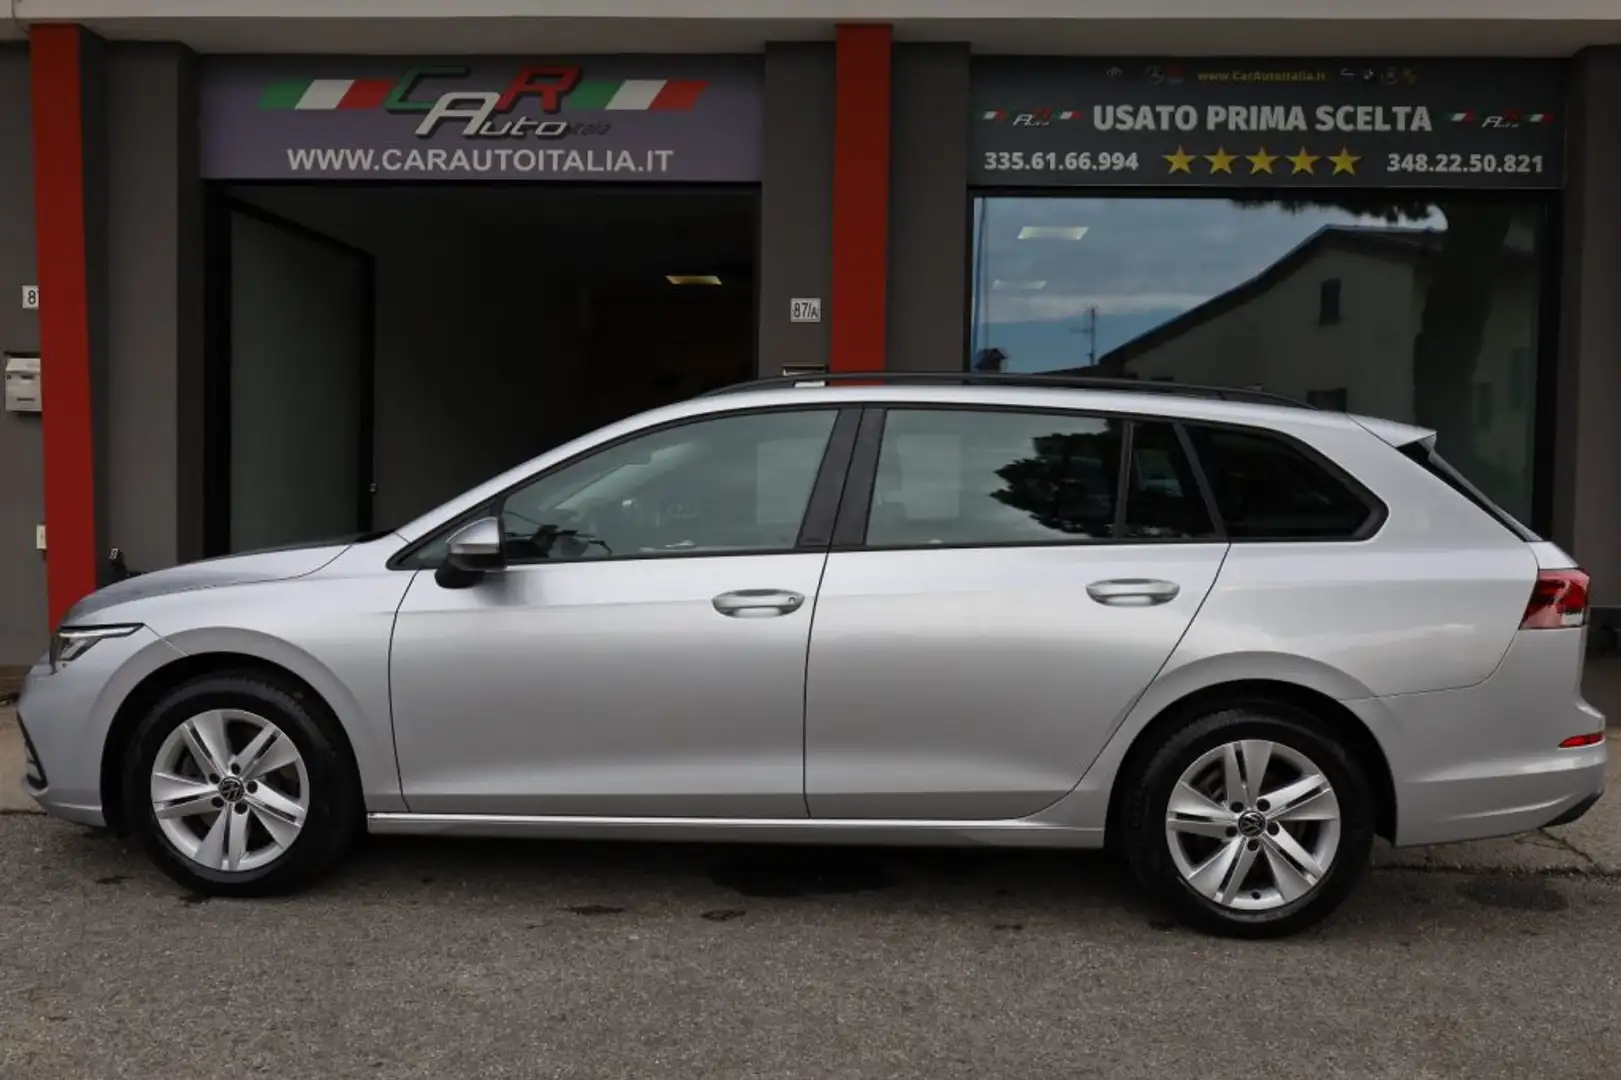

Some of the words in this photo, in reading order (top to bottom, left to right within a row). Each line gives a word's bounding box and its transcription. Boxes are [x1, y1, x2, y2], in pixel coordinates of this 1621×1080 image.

[1093, 105, 1198, 131] USATO
[1206, 105, 1308, 131] PRIMA
[1314, 105, 1433, 132] SCELTA
[286, 148, 674, 173] WWW.CARAUTOITALIA.IT
[984, 152, 1139, 171] 335.61.66.994
[1386, 153, 1544, 173] 348.22.50.821
[793, 302, 818, 318] 87/A
